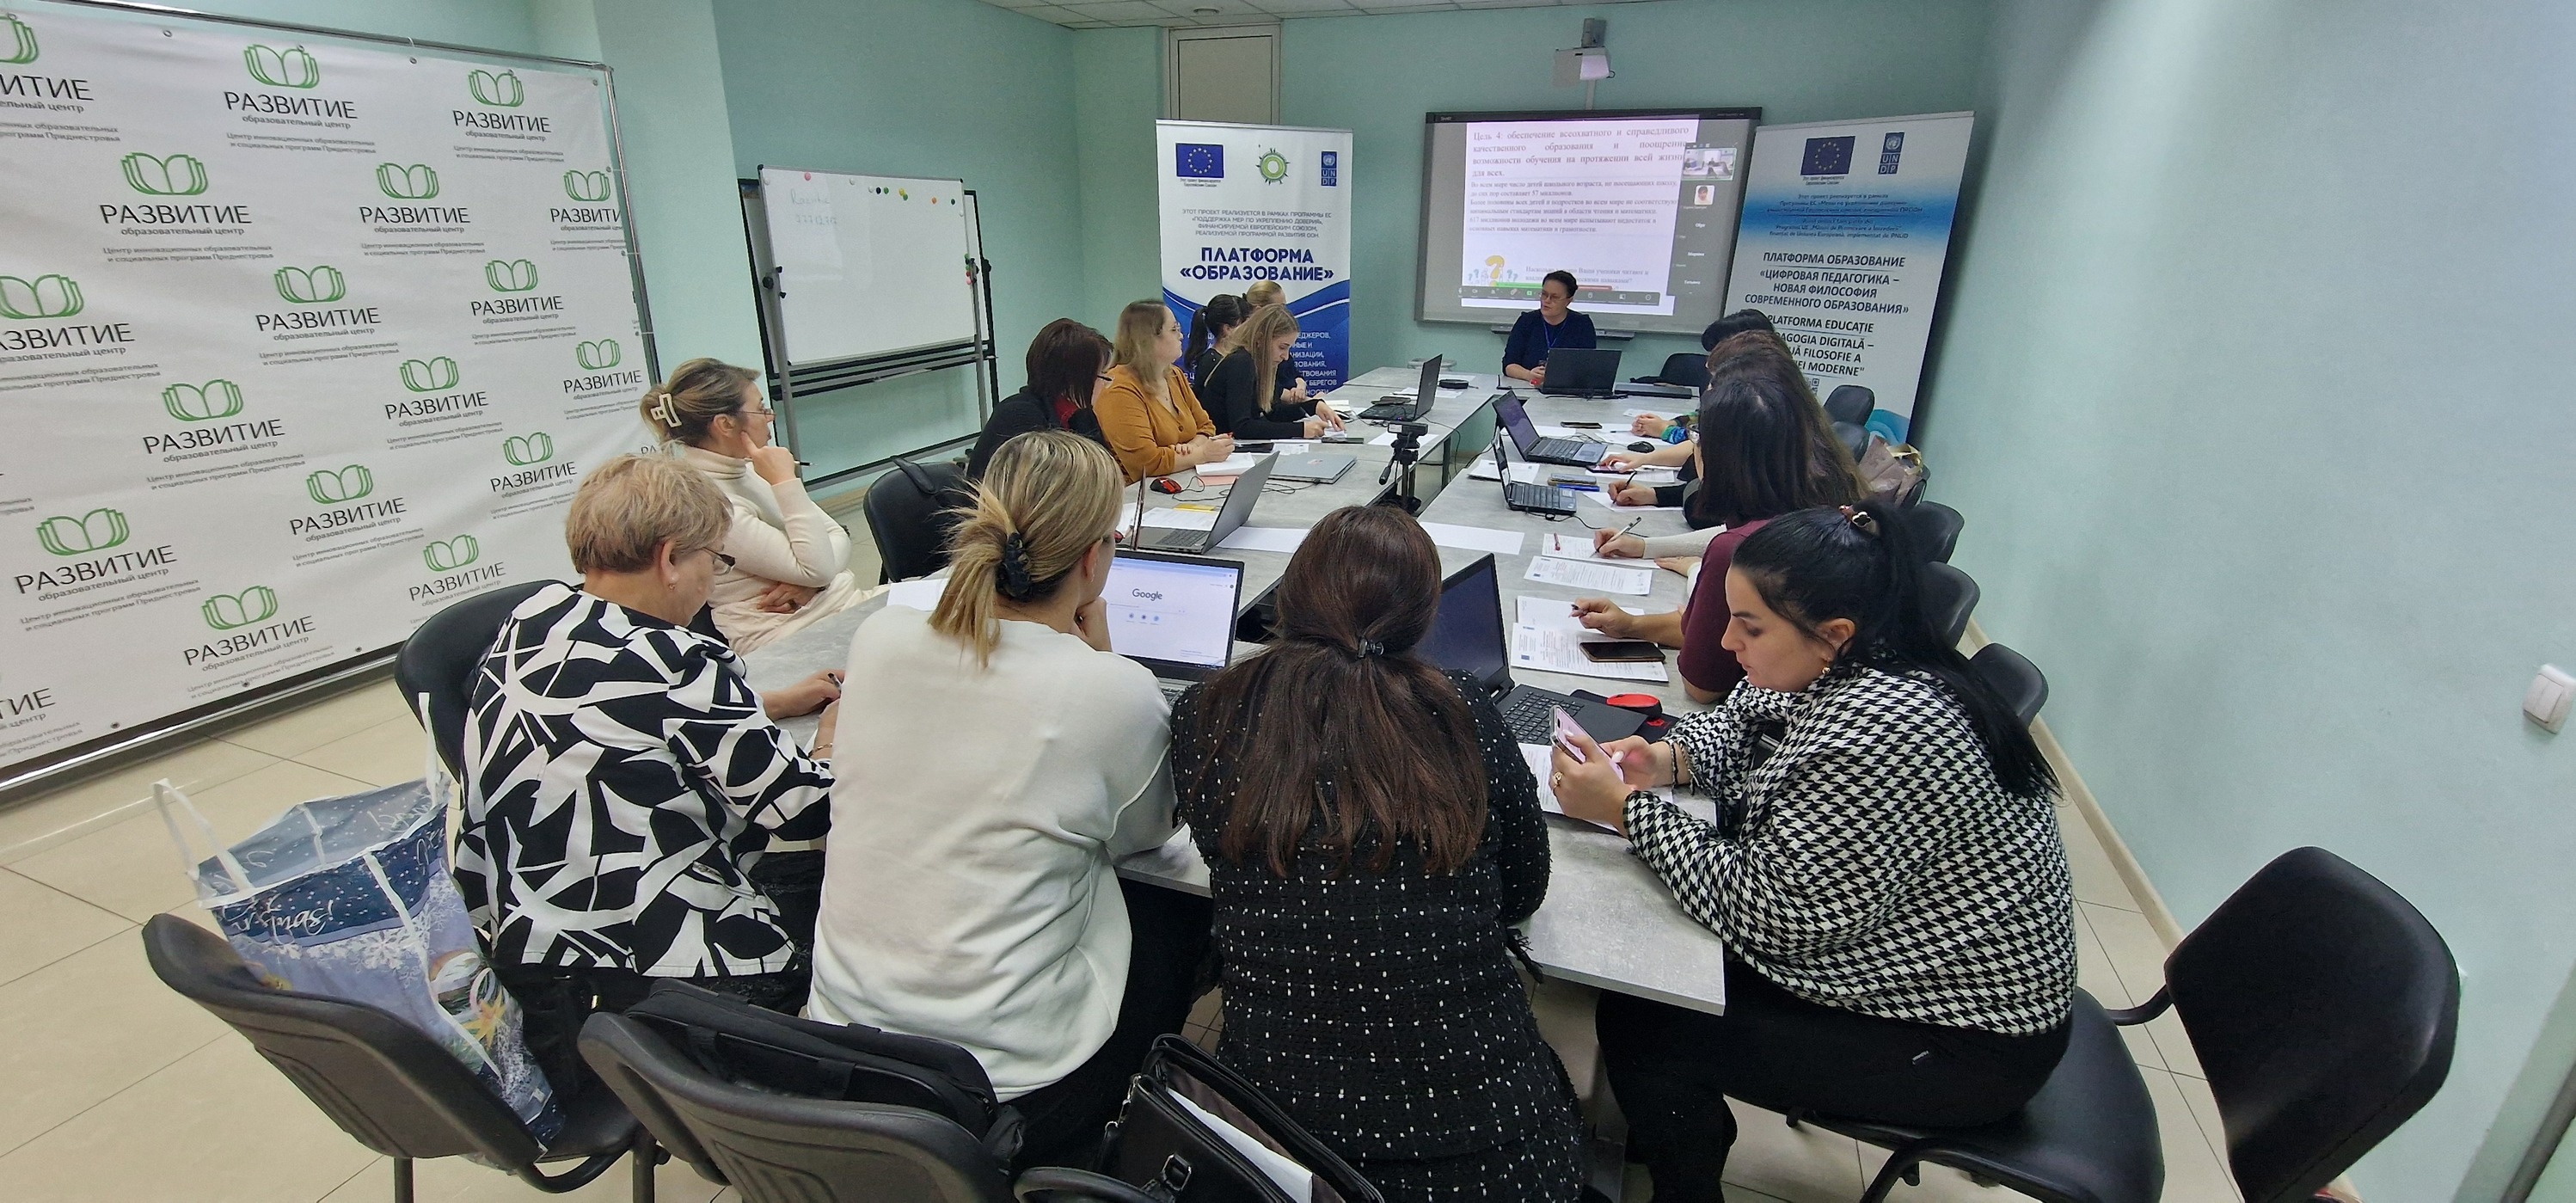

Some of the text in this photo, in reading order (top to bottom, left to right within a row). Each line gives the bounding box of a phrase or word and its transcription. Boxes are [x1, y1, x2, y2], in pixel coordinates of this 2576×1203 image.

[48, 103, 84, 114] центр
[224, 91, 358, 119] РАЗВИТИЕ
[242, 115, 351, 130] образовательный центр
[452, 110, 551, 132] РАЗВИТИЕ
[466, 131, 524, 140] образовательный
[1474, 132, 1493, 141] Цель
[1507, 130, 1555, 140] обеспечение
[1560, 129, 1612, 138] всеохватного
[1626, 127, 1689, 138] справедливого
[1473, 144, 1526, 153] качественного
[1544, 142, 1593, 152] образования
[1473, 157, 1521, 165] возможности
[1525, 156, 1561, 165] обучения
[1579, 156, 1629, 164] протяжении
[1882, 155, 1898, 163] UN
[1880, 165, 1896, 174] DP
[100, 205, 252, 224] РАЗВИТИЕ
[359, 206, 471, 224] РАЗВИТИЕ
[121, 227, 213, 236] образовательный
[374, 225, 441, 234] образовательный
[1201, 247, 1314, 263] ПЛАТФОРМА
[1763, 252, 1905, 267] ПЛАТФОРМА ОБРАЗОВАНИЕ
[1180, 265, 1334, 281] «ОБРАЗОВАНИЕ»
[1760, 269, 1819, 281] «ЦИФРОВАЯ
[1821, 272, 1890, 285] ПЕДАГОГИКА
[1773, 283, 1878, 298] НОВАЯ ФИЛОСОФИЯ
[470, 296, 564, 316] РАЗВИТИЕ
[1745, 293, 1909, 315] СОВРЕМЕННОГО ОБРАЗОВАНИЯ»
[255, 307, 382, 331] РАЗВИТИЕ
[1768, 315, 1823, 328] PLATFORMA
[0, 322, 135, 351] ЗВИТИЕ
[273, 328, 375, 341] образовательный центр
[1776, 332, 1817, 345] AGOGIA
[1819, 336, 1865, 350] DIGITALĂ
[0, 347, 126, 363] азовательный центр
[1804, 348, 1851, 362] FILOSOFIE
[1854, 353, 1861, 363] A
[563, 370, 642, 393] РАЗВИТИЕ
[384, 391, 488, 420] РАЗВИТИЕ
[399, 409, 483, 427] образовательный центр
[142, 419, 285, 454] РАЗВИТИЕ
[163, 440, 278, 463] образовательный центр
[490, 461, 578, 492] РАЗВИТИЕ
[290, 497, 407, 535] РАЗВИТИЕ
[305, 517, 402, 542] образовательный центр
[14, 545, 177, 594] РАЗВИТИЕ
[39, 567, 169, 602] образовательный центр
[409, 562, 506, 601] РАЗВИТИЕ
[21, 611, 52, 624] Центр
[126, 579, 199, 599] образовательных
[1132, 588, 1162, 601] Google
[91, 601, 135, 616] программ
[183, 616, 316, 666] РАЗВИТИЕ
[202, 636, 309, 672] образовательный центр
[9, 714, 46, 727] центр
